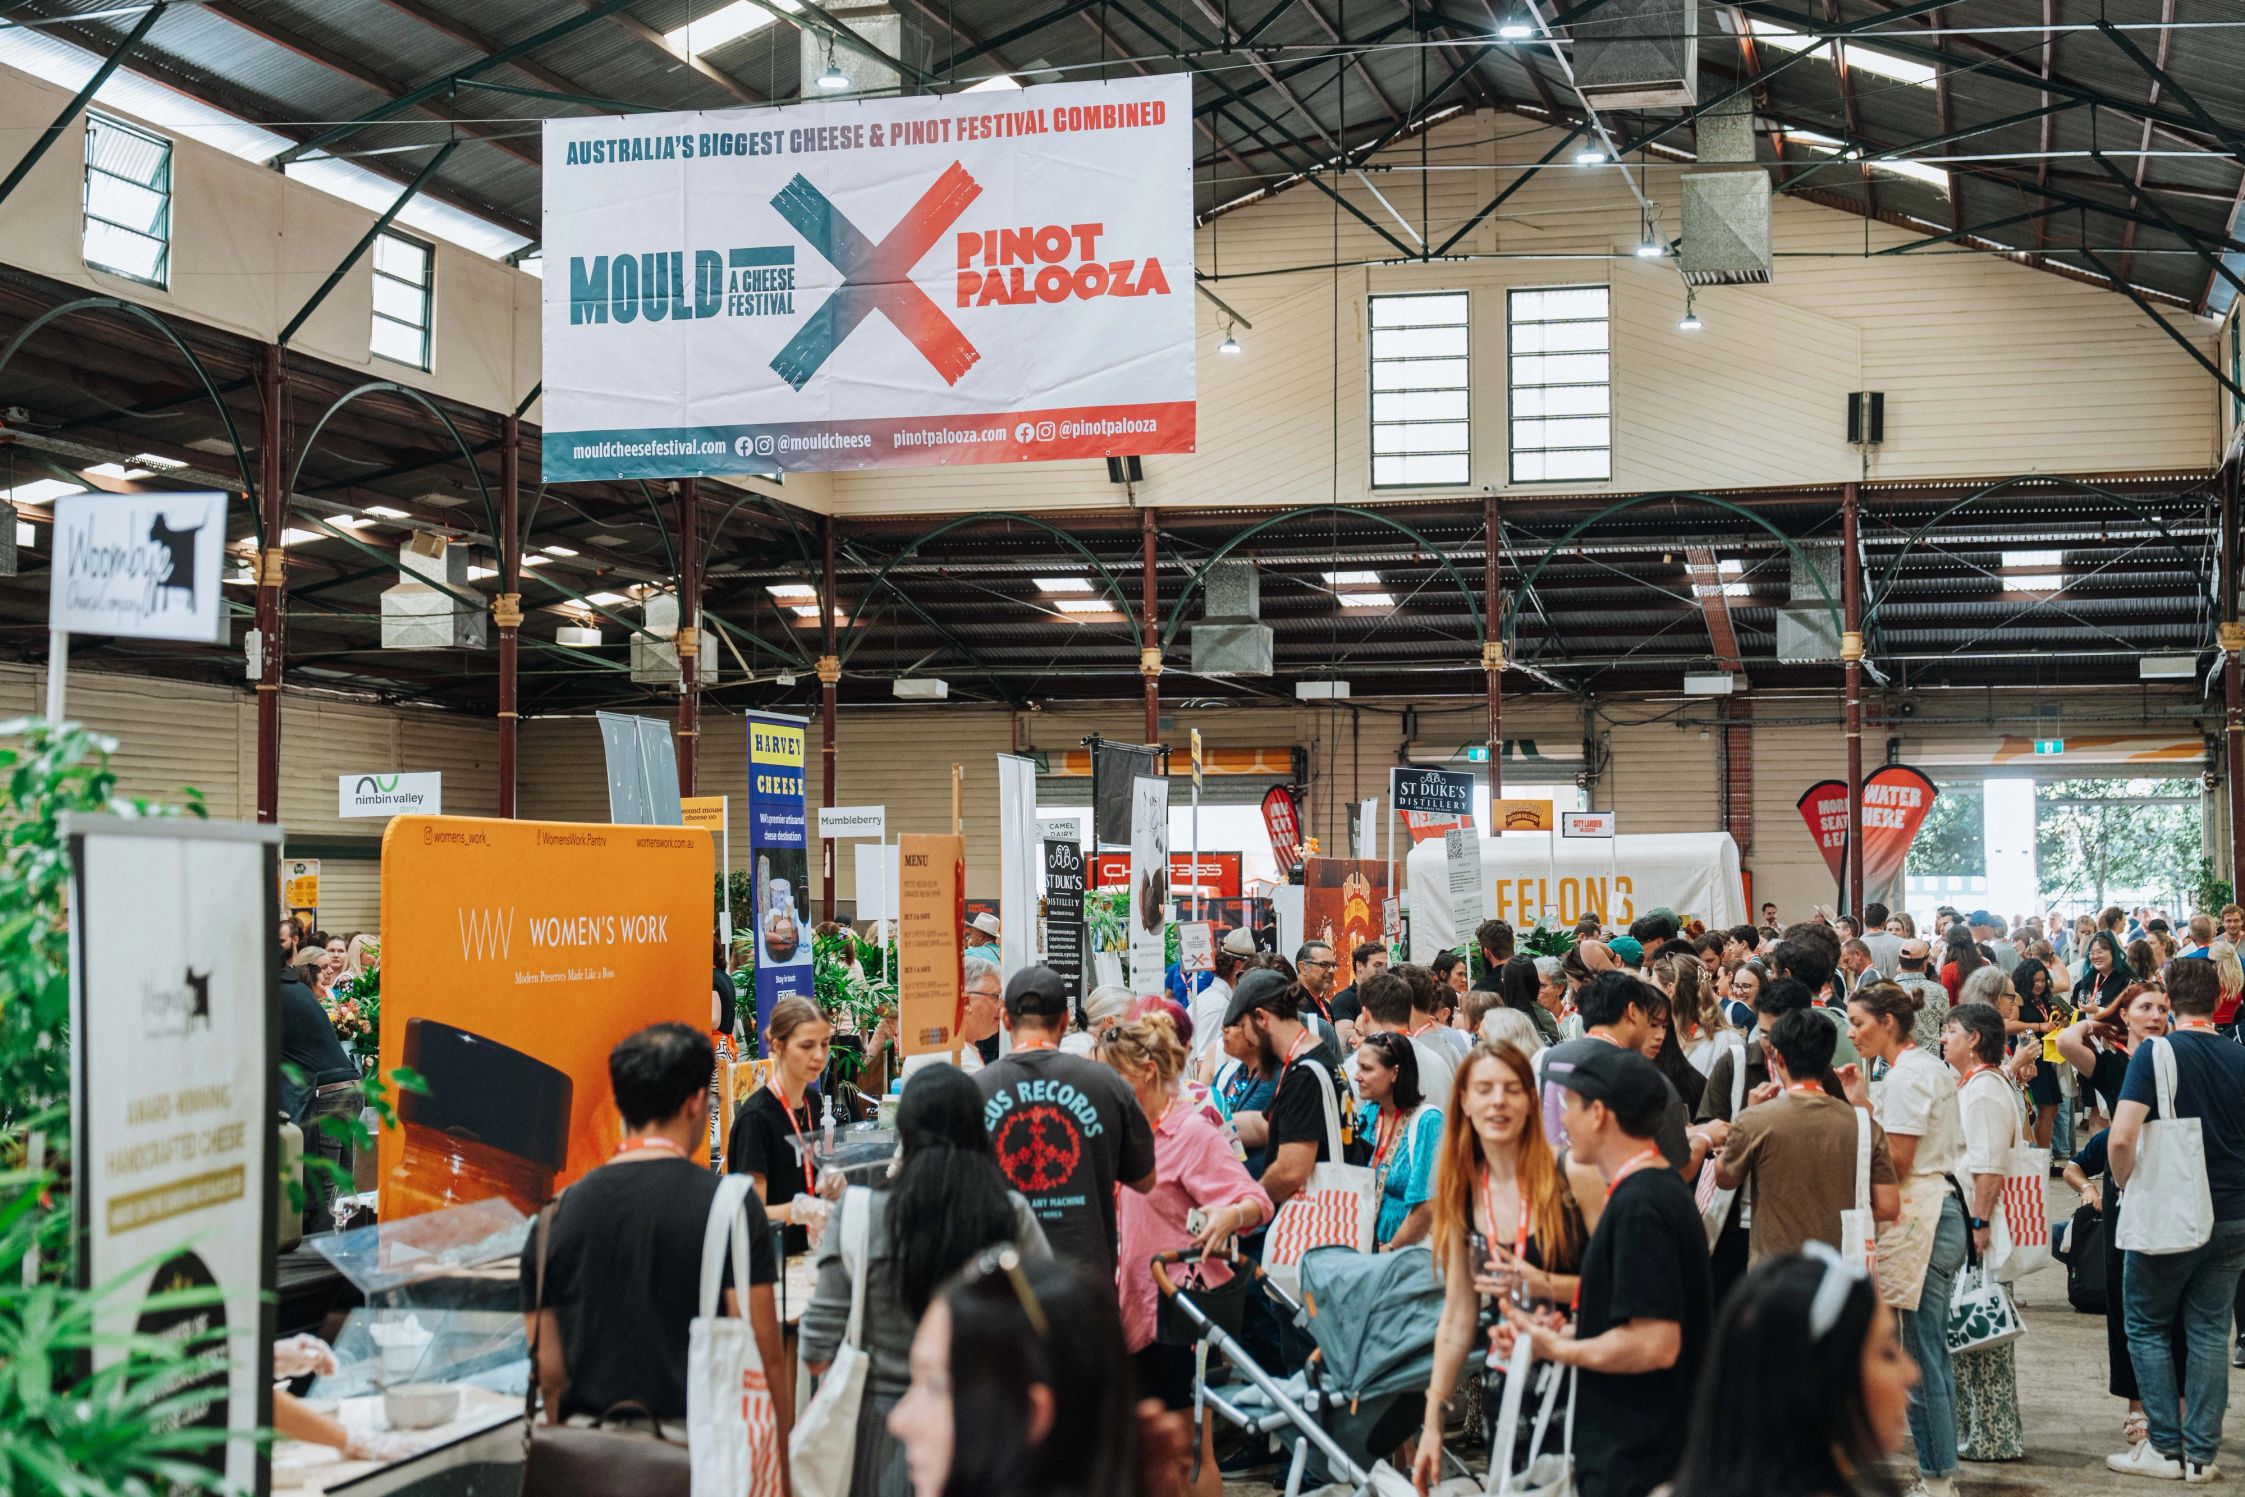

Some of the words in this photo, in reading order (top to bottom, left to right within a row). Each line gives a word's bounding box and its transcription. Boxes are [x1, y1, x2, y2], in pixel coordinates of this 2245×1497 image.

[566, 134, 694, 166] AUSTRALIA'S
[699, 130, 784, 157] BIGGEST
[790, 124, 864, 154] CHEESE
[869, 123, 884, 148] &
[890, 118, 951, 147] PINOT
[956, 108, 1048, 142] FESTIVAL
[1054, 100, 1166, 132] COMBINED
[957, 222, 1104, 270] PINOT
[570, 249, 723, 325] MOULD
[729, 270, 739, 292] A
[742, 267, 795, 292] CHEESE
[956, 257, 1171, 308] PALOOZA
[728, 288, 795, 317] FESTIVAL
[573, 438, 726, 460] mouldcheesefestival.com
[778, 432, 872, 454] @mouldcheese
[894, 426, 1006, 448] pinotpalooza.com
[1059, 417, 1157, 440] @pinotpalooza
[755, 734, 801, 756] HARVEY
[757, 775, 804, 796] CHEESE
[1400, 782, 1417, 796] ST
[1420, 783, 1466, 799] DUKE'S
[1864, 784, 1922, 808] WATER
[356, 794, 392, 805] nimbin
[394, 792, 424, 804] valley
[400, 804, 419, 814] dairy
[1399, 797, 1467, 810] DISTILLERY
[821, 816, 882, 826] Mumbleberry
[1862, 806, 1906, 829] HERE
[434, 828, 491, 846] womens_work_
[636, 836, 694, 849] womenswork.com.au
[1823, 833, 1832, 848] &
[904, 854, 929, 867] MENU
[529, 916, 615, 948] WOMEN'S
[620, 914, 668, 944] WORK
[514, 972, 538, 984] Modern
[567, 968, 583, 981] Made
[584, 968, 596, 980] Like
[1016, 1080, 1104, 1138] RECORDS
[1050, 1195, 1086, 1208] MACHINE
